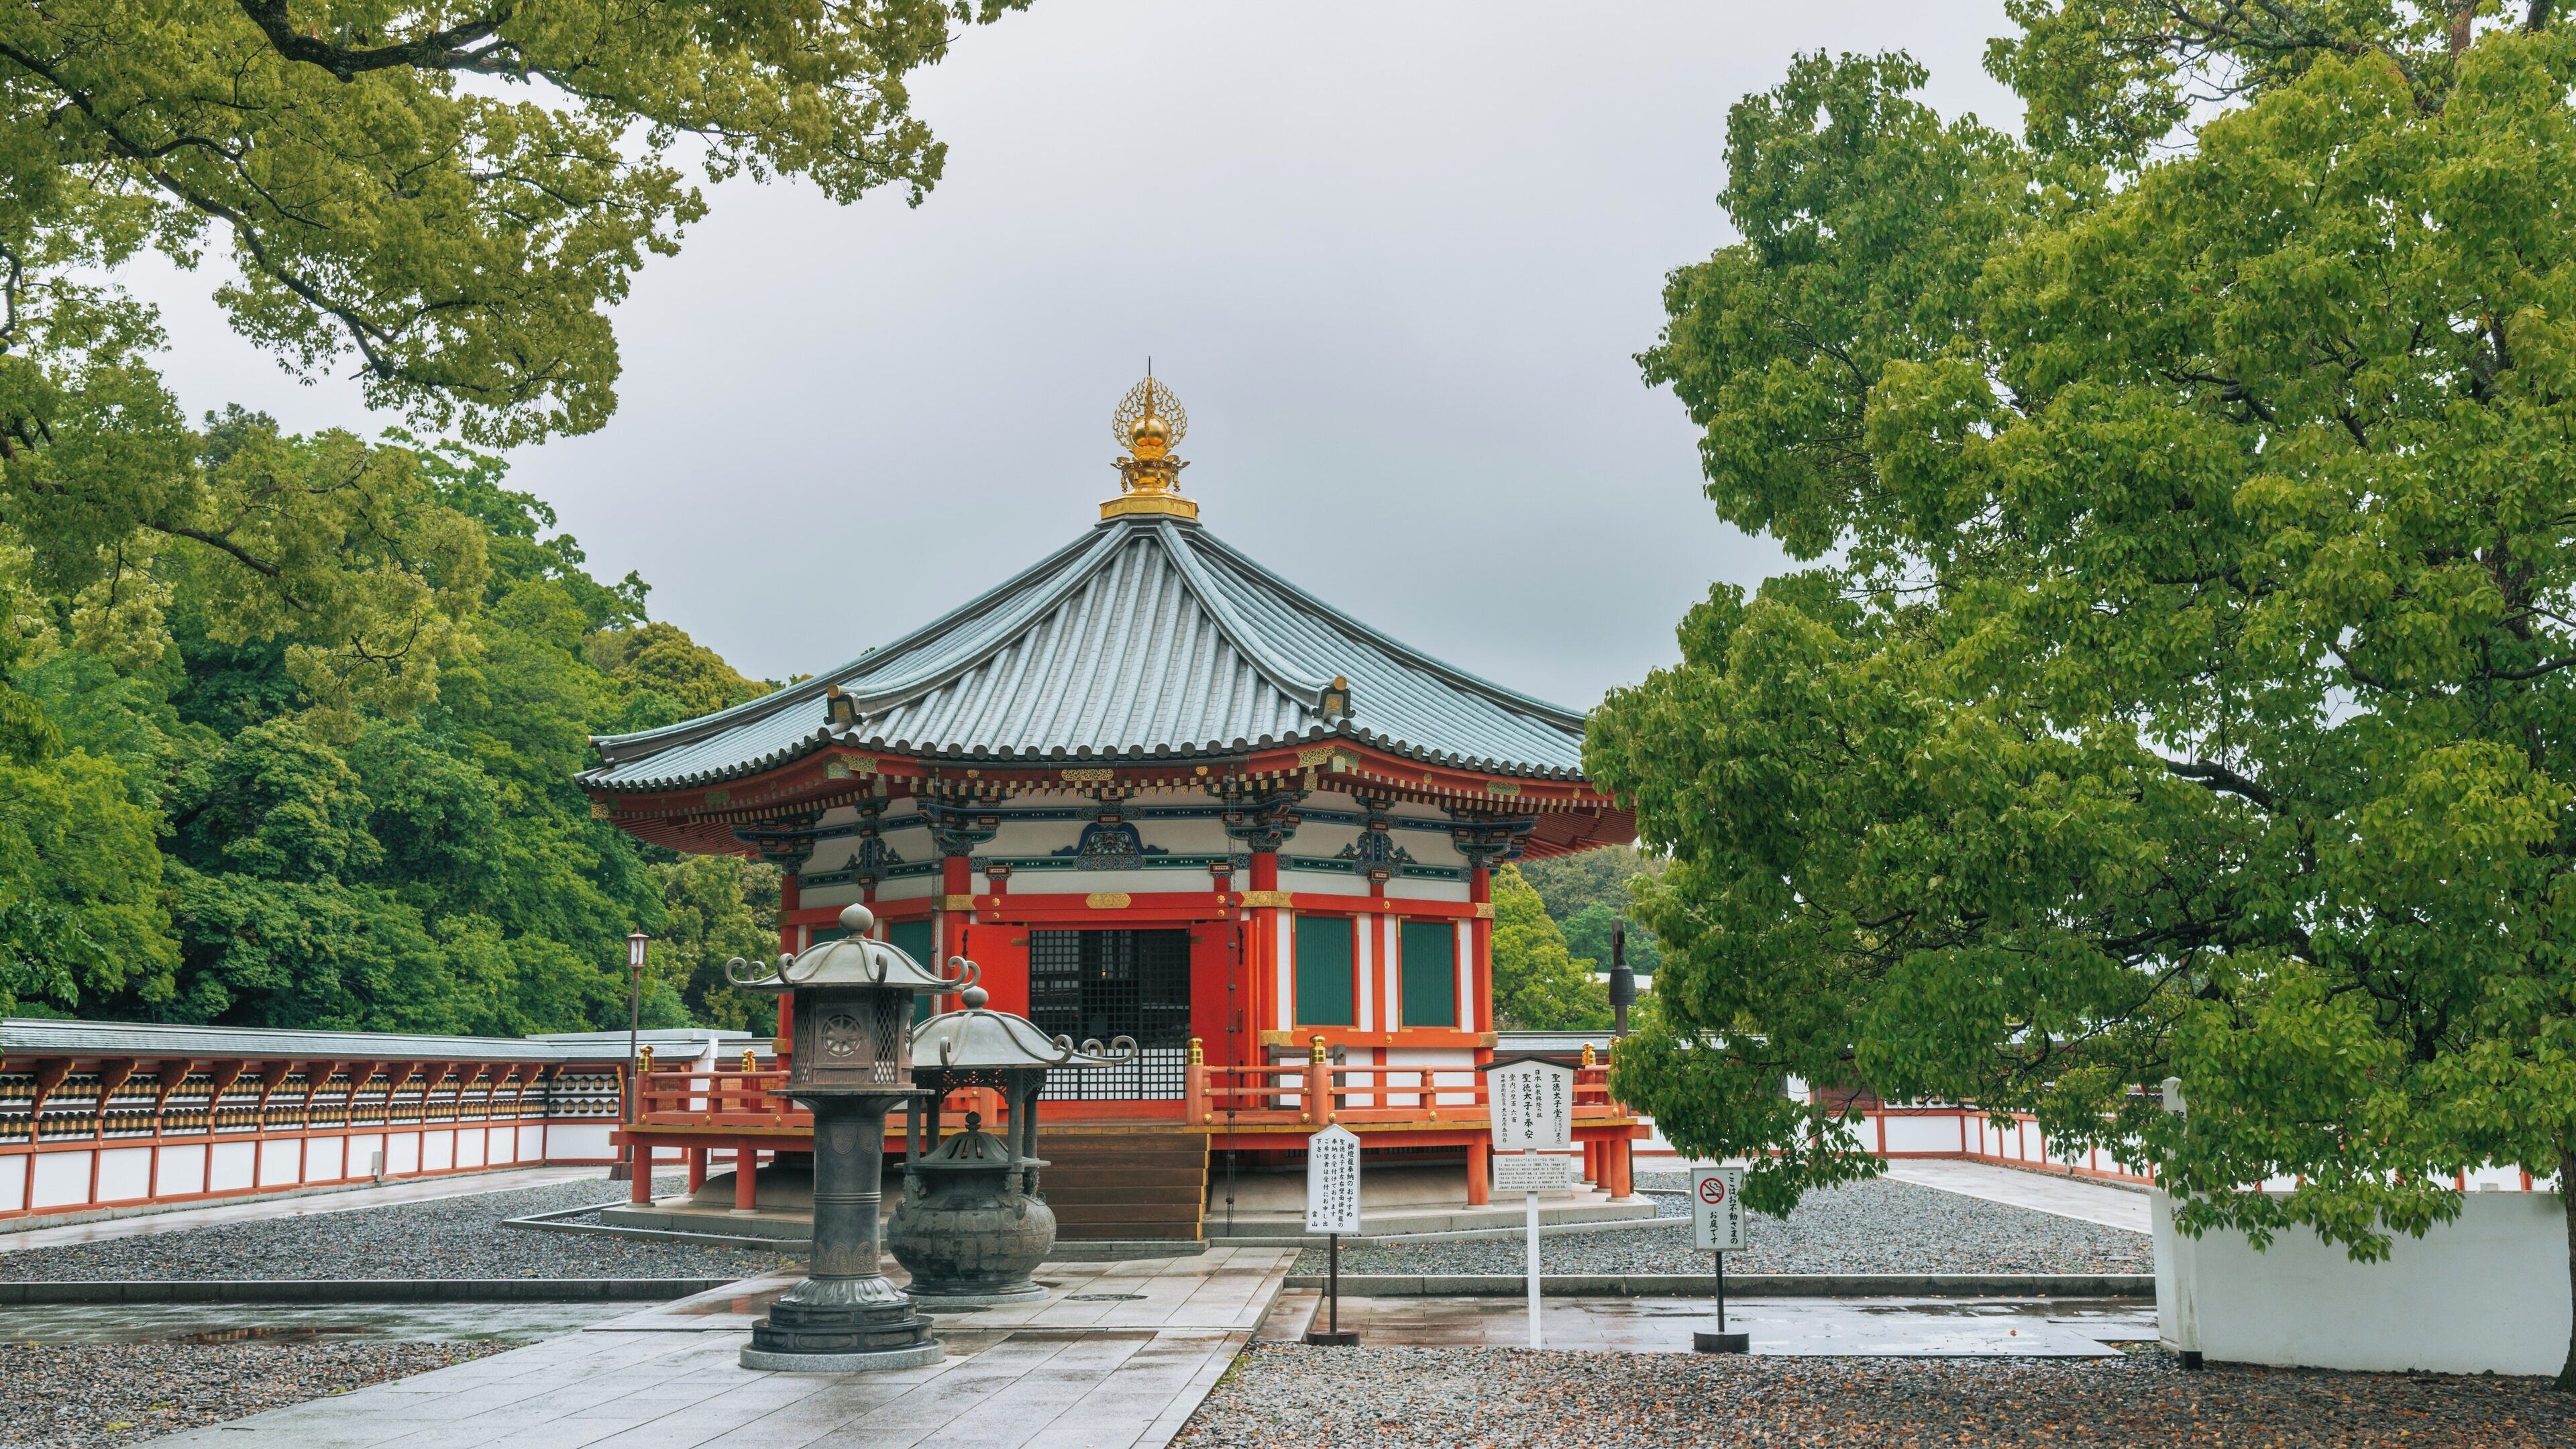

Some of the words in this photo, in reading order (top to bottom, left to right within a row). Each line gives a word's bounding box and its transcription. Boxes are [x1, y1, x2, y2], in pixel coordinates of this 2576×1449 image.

[1522, 1073, 1534, 1139] 聖徳太子を奉安
[1534, 1069, 1542, 1118] 日本仏教興隆の祖
[1552, 1073, 1562, 1118] 聖徳太子堂
[1346, 1142, 1354, 1218] 掛燈籠奉納のおすすめ
[1729, 1172, 1738, 1244] ここはお不動さまの
[1709, 1211, 1718, 1244] お庭です
